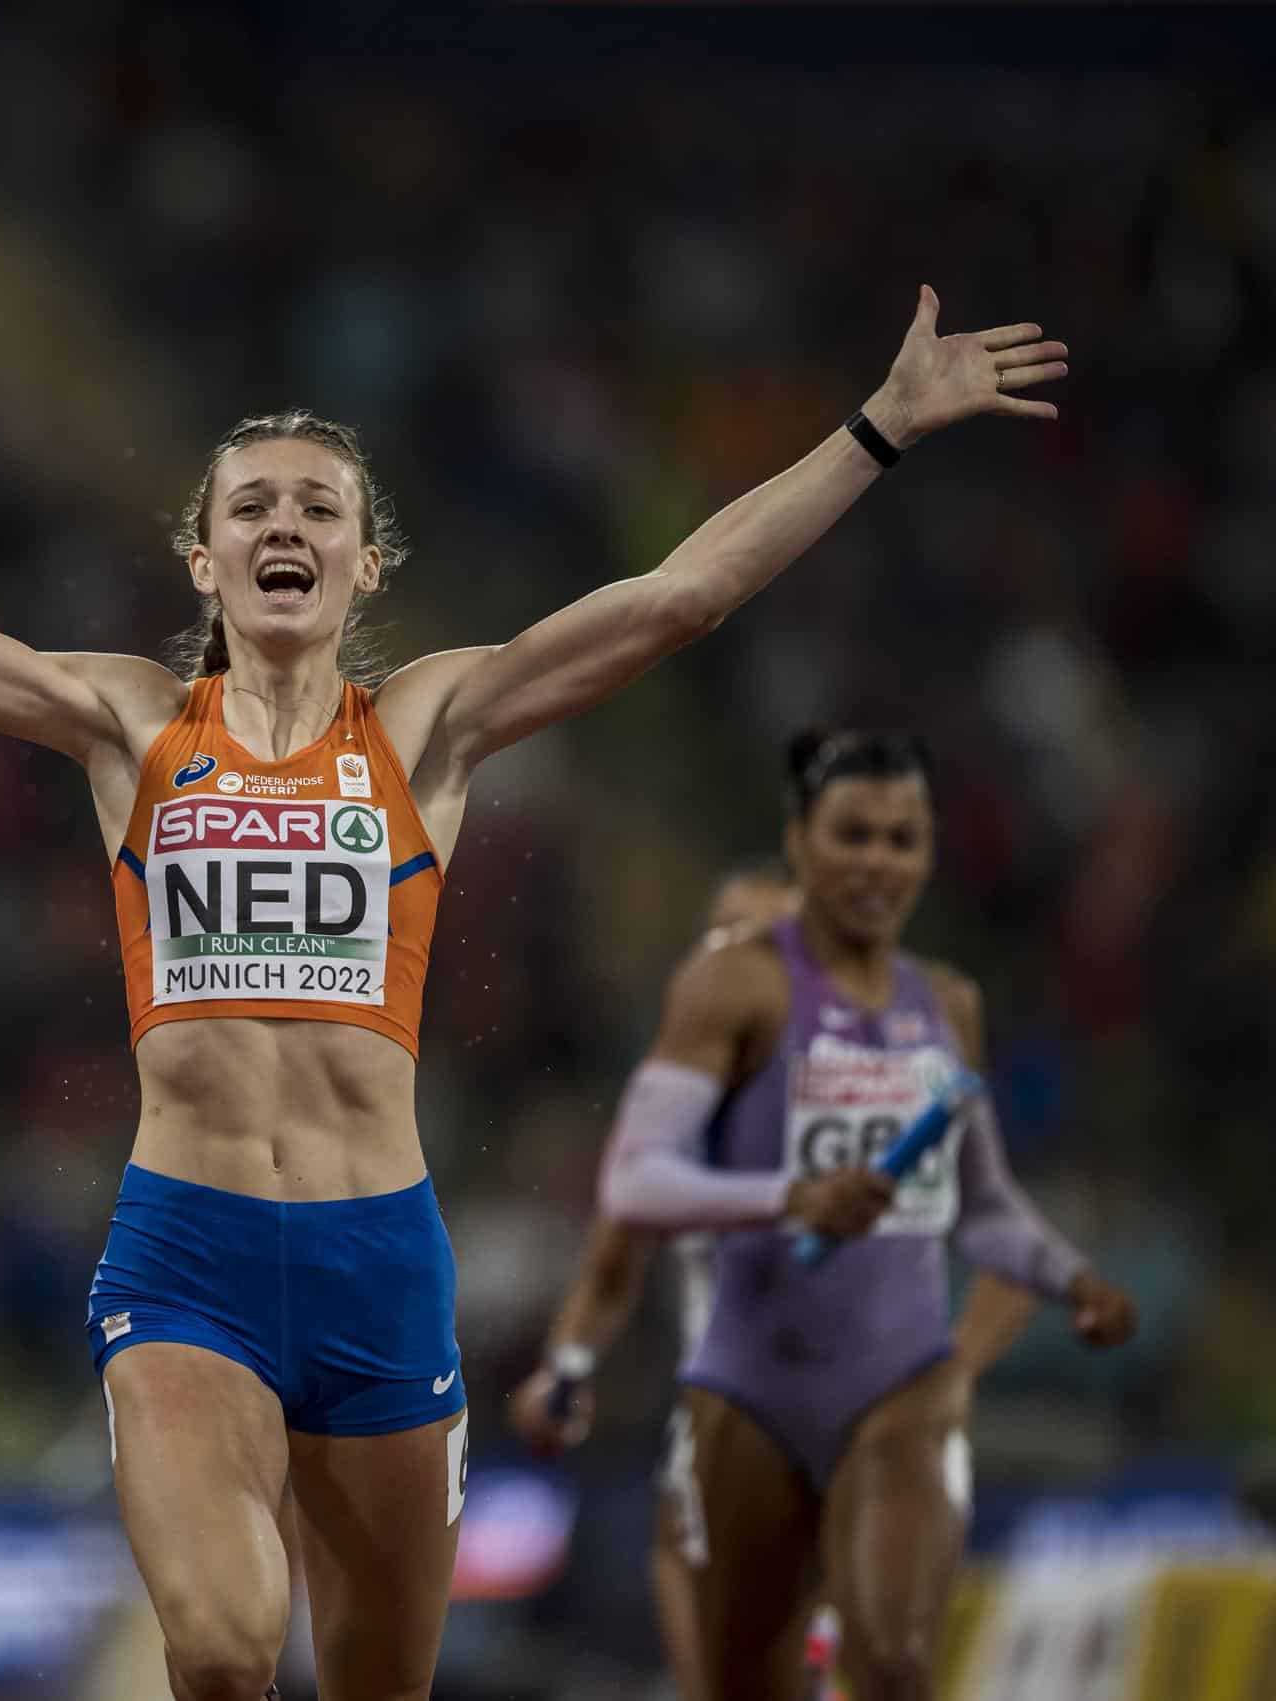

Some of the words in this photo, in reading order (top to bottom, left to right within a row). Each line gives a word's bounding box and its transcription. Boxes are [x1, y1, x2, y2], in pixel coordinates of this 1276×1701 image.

[244, 784, 298, 796] LOTERIJ
[245, 775, 325, 786] NEDERLANDSE
[158, 806, 321, 846] SPAR
[164, 860, 368, 939] NED
[199, 936, 205, 953] I
[211, 936, 255, 954] RUN
[165, 962, 286, 994] MUNICH
[298, 963, 372, 995] 2022
